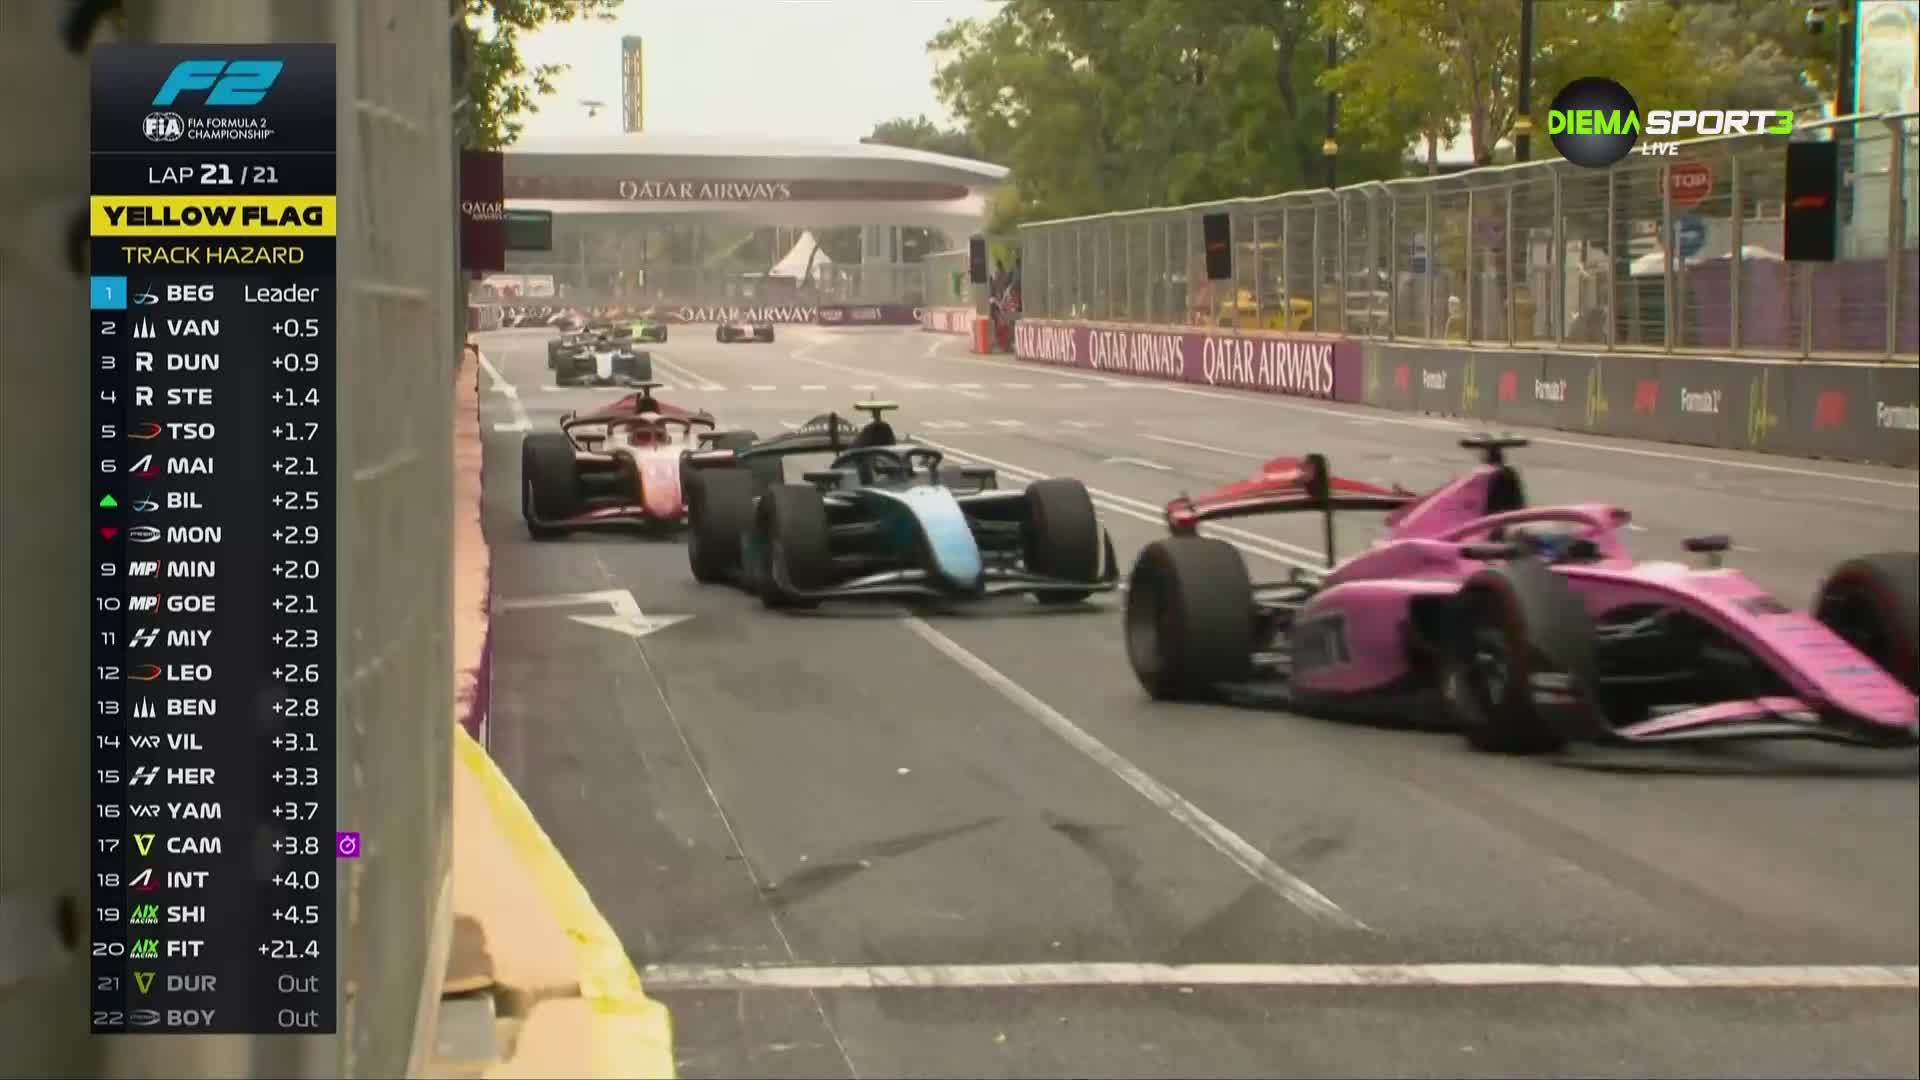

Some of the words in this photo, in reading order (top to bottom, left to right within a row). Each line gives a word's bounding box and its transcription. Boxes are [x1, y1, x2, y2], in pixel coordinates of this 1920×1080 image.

[618, 180, 693, 200] QATAR
[699, 182, 792, 199] AIRWAYS
[462, 202, 502, 216] QATAR
[1089, 330, 1128, 369] QATAR
[1129, 333, 1184, 376] AIRWAYS
[1203, 337, 1254, 384] QATAR
[1258, 340, 1334, 392] AIRWAYS
